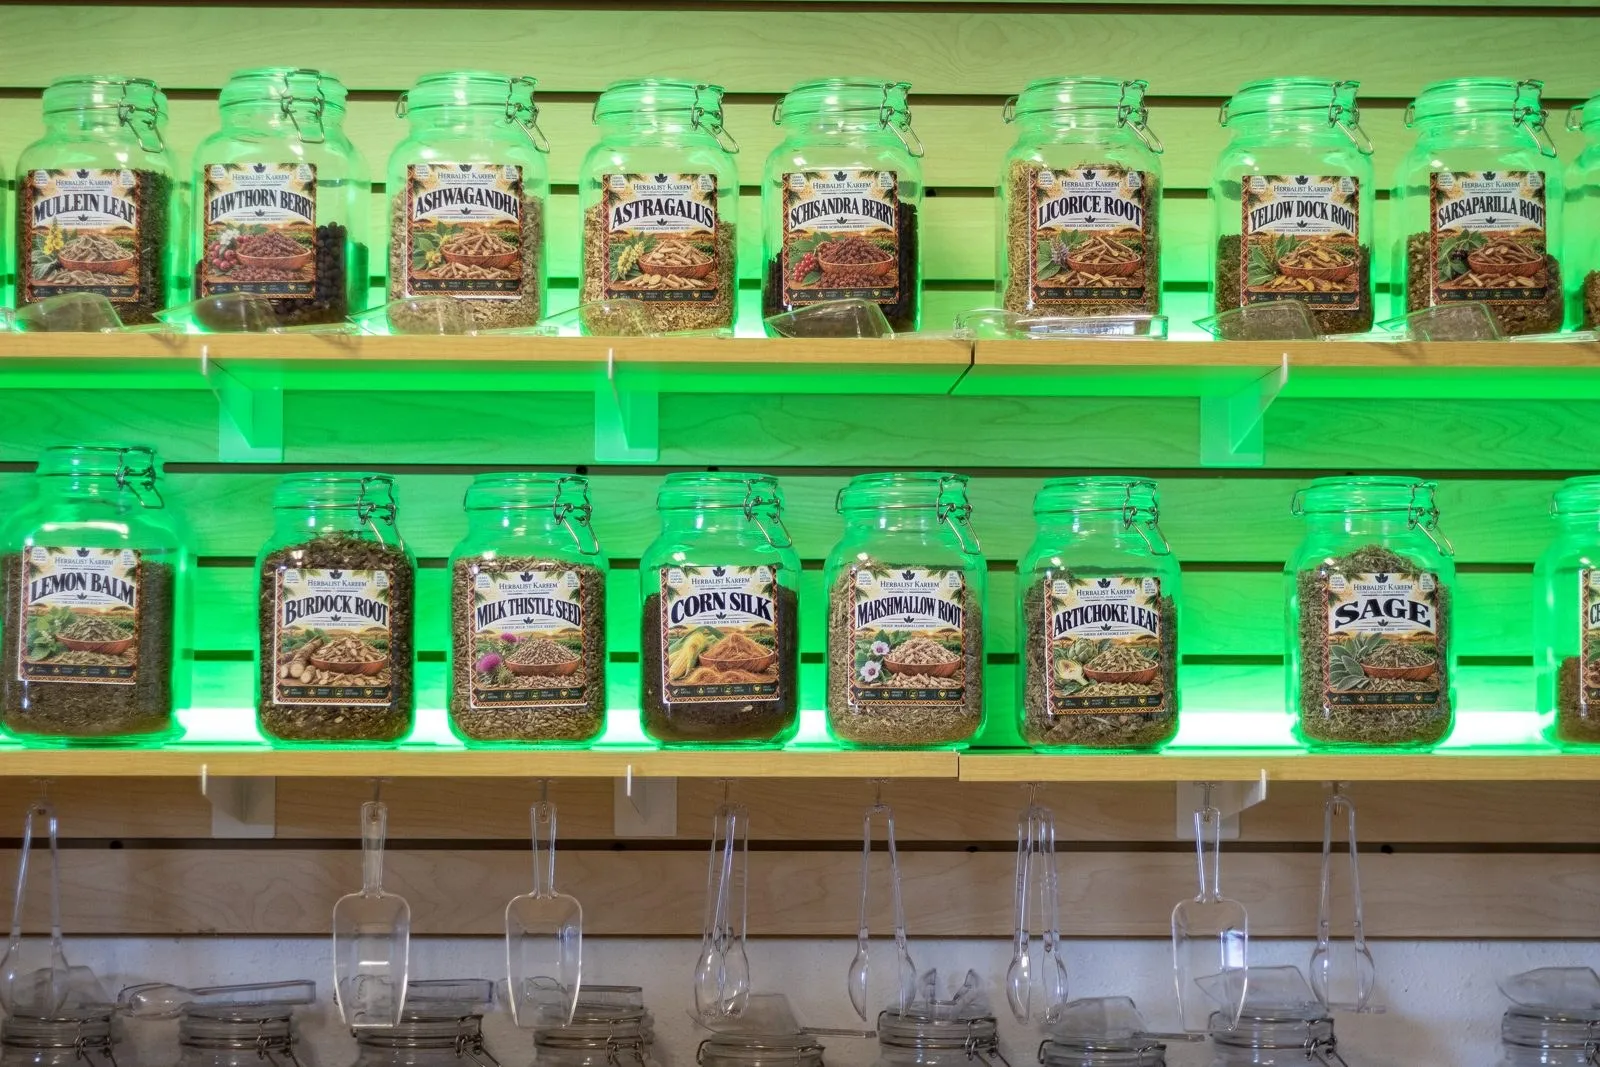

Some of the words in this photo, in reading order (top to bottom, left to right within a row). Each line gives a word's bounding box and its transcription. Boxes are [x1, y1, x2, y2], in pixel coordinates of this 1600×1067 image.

[34, 193, 100, 224] MULLEIN
[104, 195, 135, 224] LEAF
[211, 189, 277, 221] HAWTHORN
[280, 191, 313, 220] BERRY
[416, 187, 518, 218] ASHWAGANDHA
[612, 198, 713, 229] ASTRAGALUS
[791, 197, 860, 228] SCHISANDRA
[862, 199, 893, 227] BERRY
[1040, 195, 1101, 226] LICORICE
[1104, 196, 1142, 226] ROOT
[1251, 203, 1294, 231] YELLOW
[1297, 200, 1329, 220] DOCK
[1439, 196, 1517, 228] SARSAPARILLA
[31, 572, 89, 603] LEMON
[91, 574, 134, 605] BALM
[285, 595, 353, 625] BURDOCK
[355, 596, 388, 626] ROOT
[478, 600, 507, 630] MILK
[508, 597, 555, 618] THISTLE
[556, 600, 581, 626] SEED
[671, 592, 726, 624] CORN
[730, 592, 772, 622] SILK
[858, 596, 936, 627] MARSHMALLOW
[1054, 604, 1129, 636] ARTICHOKE
[1335, 598, 1431, 629] SAGE
